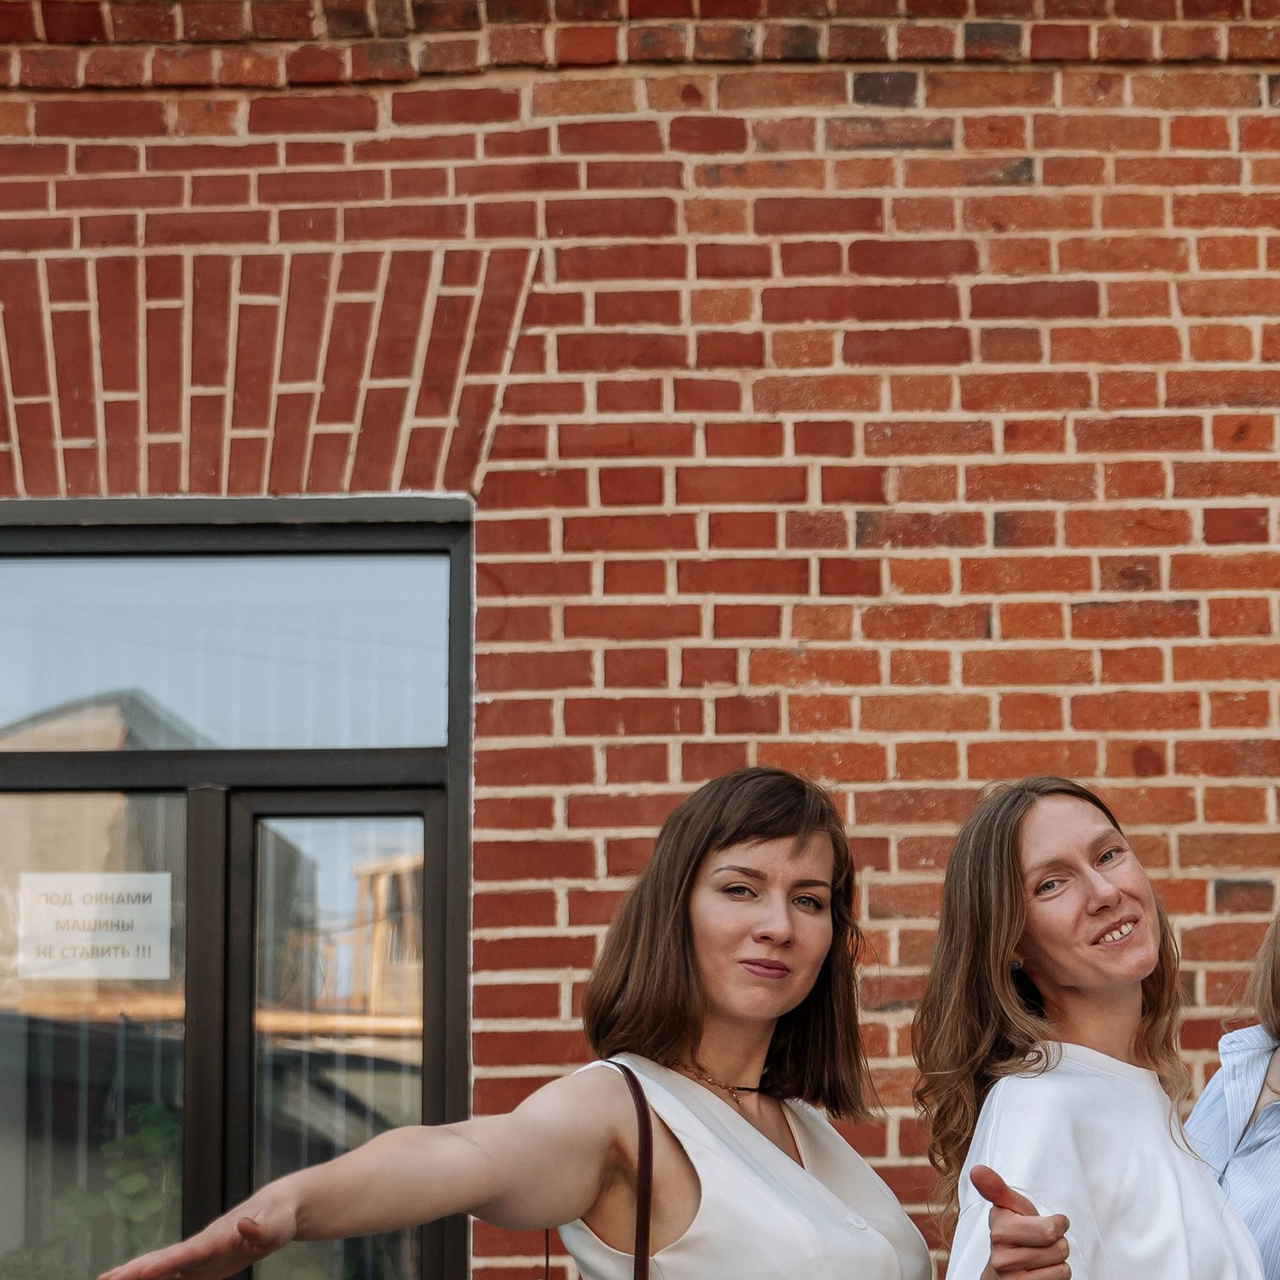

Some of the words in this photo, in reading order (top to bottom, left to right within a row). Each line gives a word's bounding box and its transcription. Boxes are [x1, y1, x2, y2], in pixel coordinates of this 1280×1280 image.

[82, 891, 153, 905] ОКНАМИ
[55, 919, 134, 932] МАШИНЫ
[61, 945, 131, 959] СТАВИТЬ
